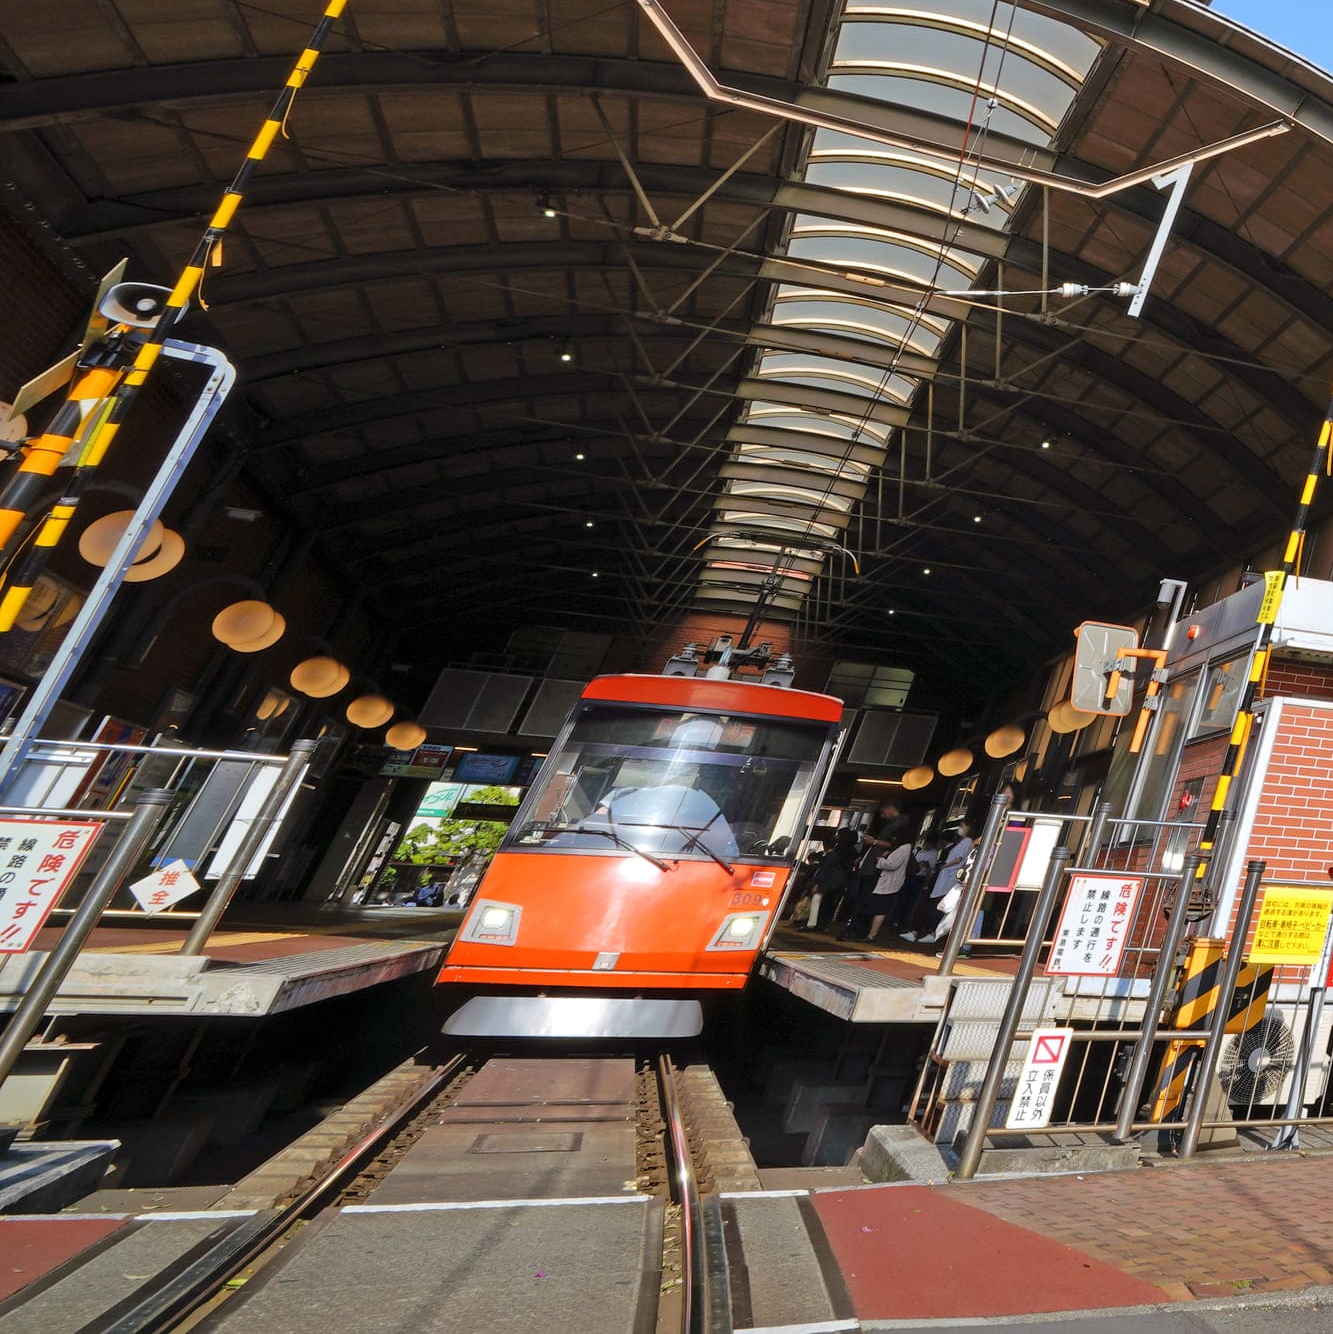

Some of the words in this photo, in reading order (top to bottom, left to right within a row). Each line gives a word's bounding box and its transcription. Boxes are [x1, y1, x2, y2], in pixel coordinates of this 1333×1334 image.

[148, 870, 181, 906] 推全
[731, 892, 762, 906] 309
[1073, 888, 1098, 950] 禁止します
[1083, 889, 1112, 964] 線路の通行を
[1014, 1069, 1039, 1122] 立入禁止
[1030, 1068, 1055, 1121] 係員以外
